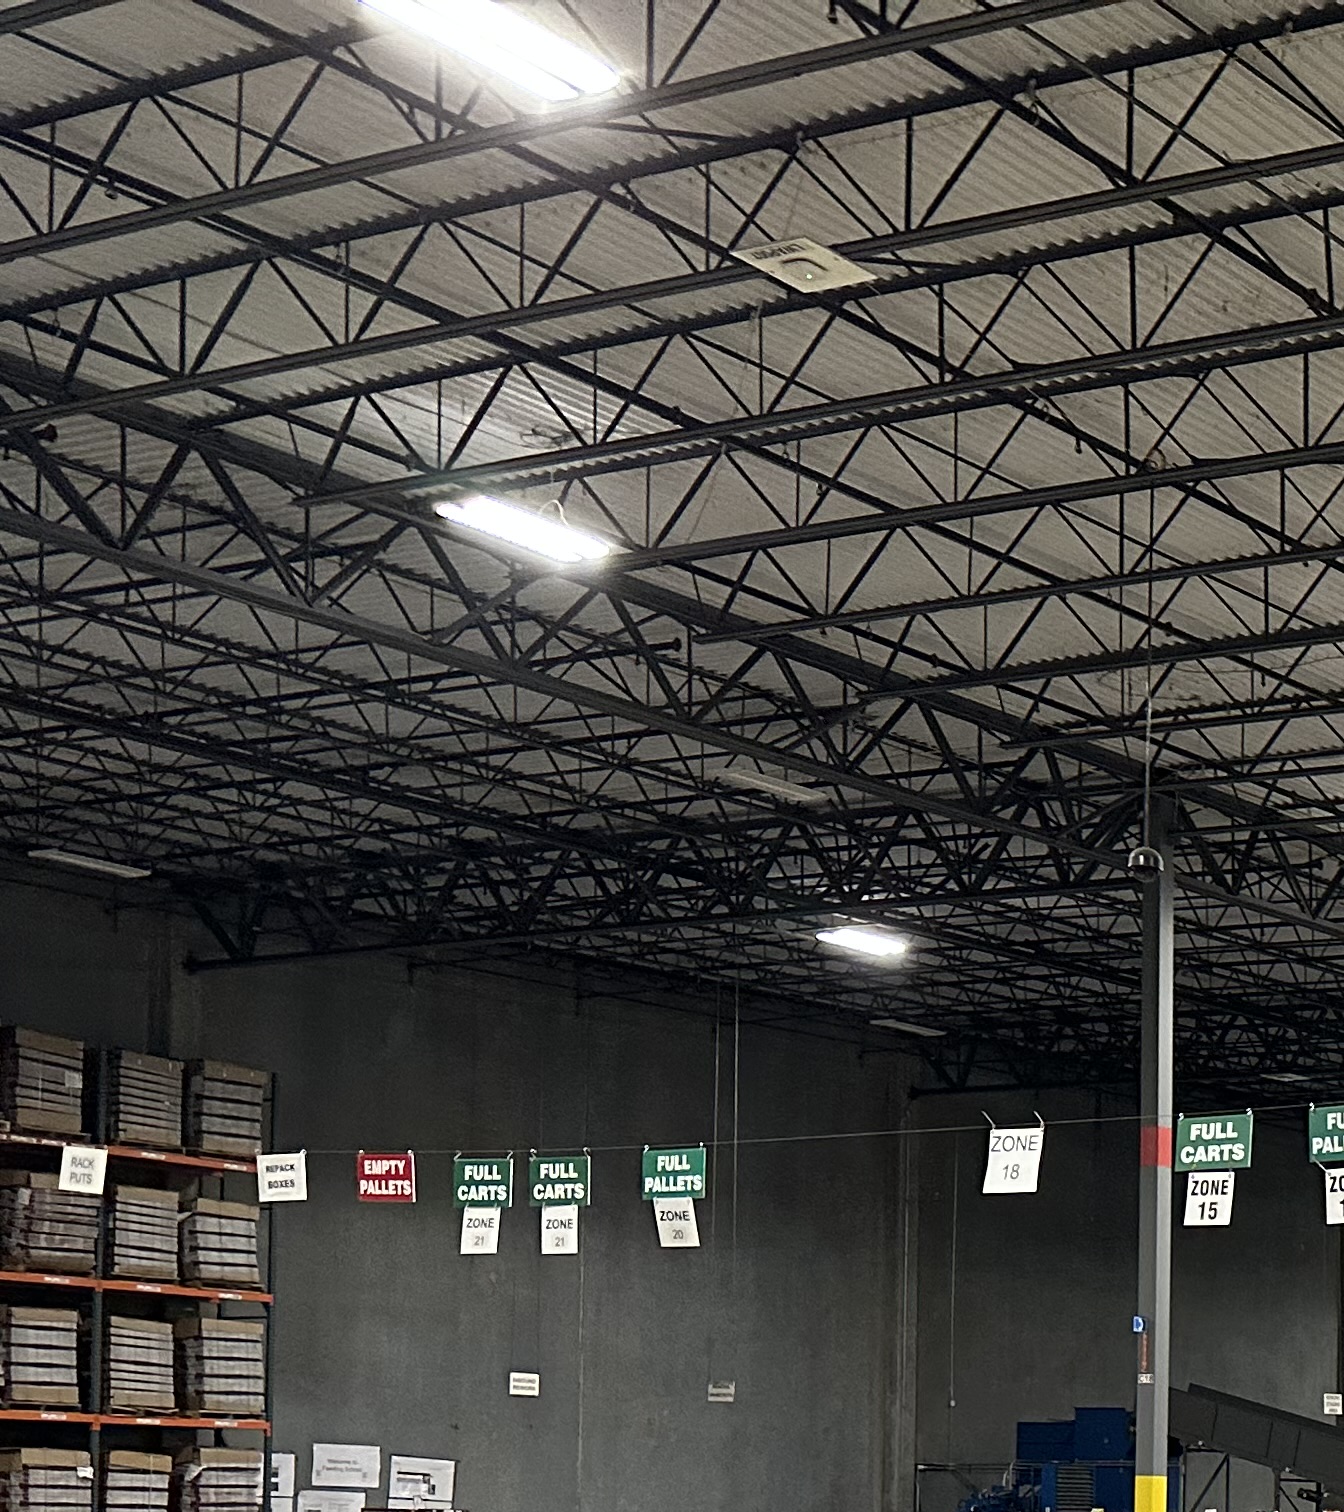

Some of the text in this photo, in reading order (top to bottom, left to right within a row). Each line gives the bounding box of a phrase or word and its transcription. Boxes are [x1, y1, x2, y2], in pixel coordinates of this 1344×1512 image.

[1190, 1121, 1238, 1141] FULL
[990, 1135, 1039, 1152] ZONE
[1180, 1143, 1245, 1164] CARTS
[265, 1163, 295, 1173] REPACK
[364, 1160, 406, 1175] EMPTY
[656, 1154, 691, 1172] FULL
[464, 1165, 501, 1180] FULL
[540, 1163, 578, 1179] FULL
[1002, 1164, 1020, 1180] 18
[268, 1179, 295, 1190] BOXES
[360, 1180, 411, 1195] PALLETS
[533, 1183, 585, 1200] CARTS
[644, 1175, 702, 1193] PALLETS
[1191, 1180, 1229, 1196] ZONE
[457, 1185, 508, 1200] CARTS
[659, 1211, 690, 1222] ZONE
[1198, 1202, 1219, 1220] 15
[466, 1218, 495, 1228] ZONE
[546, 1219, 574, 1229] ZONE
[474, 1236, 485, 1246] 21
[672, 1229, 684, 1239] 20
[555, 1237, 565, 1247] 21
